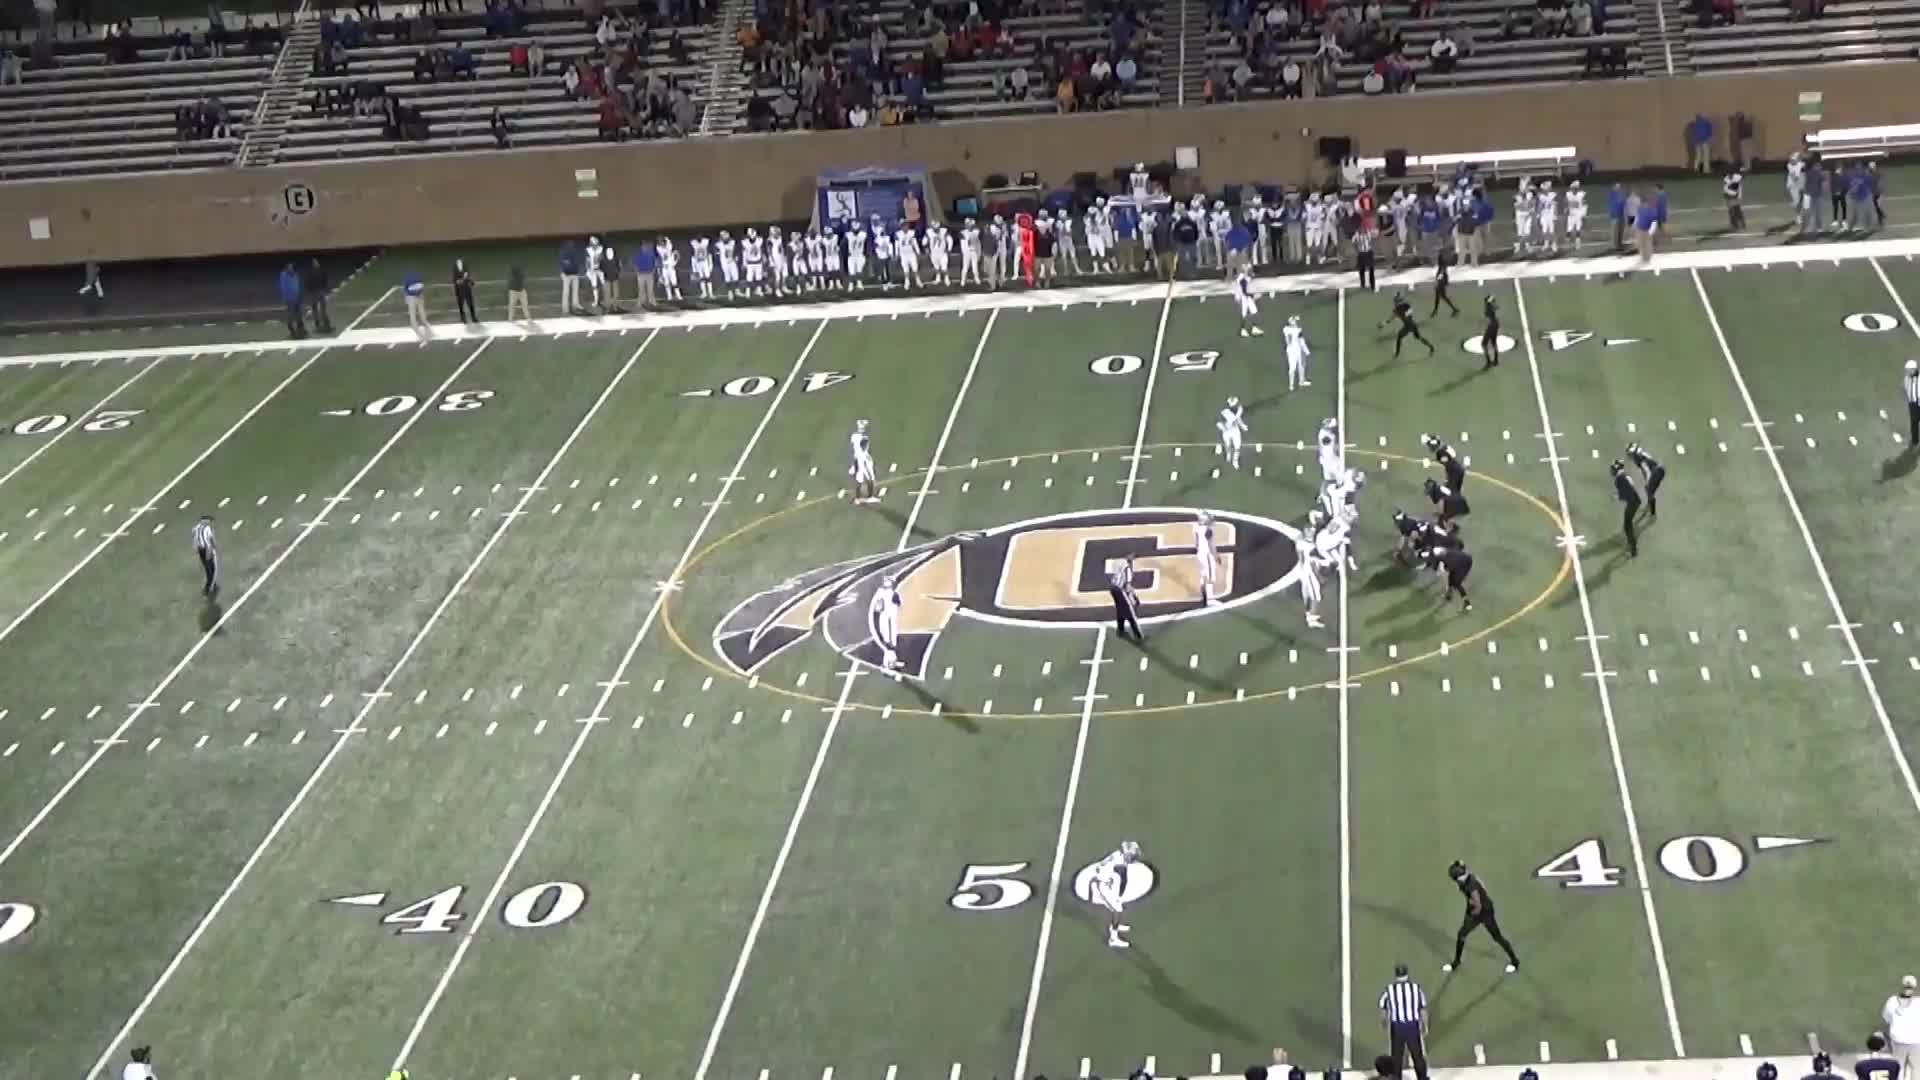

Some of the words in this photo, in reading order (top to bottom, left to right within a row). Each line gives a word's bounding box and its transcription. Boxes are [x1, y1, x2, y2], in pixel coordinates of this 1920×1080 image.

[1090, 351, 1220, 375] 50
[723, 371, 853, 396] 40
[364, 391, 495, 416] 30
[994, 521, 1236, 609] G
[1536, 833, 1743, 887] 40
[382, 881, 585, 934] 40
